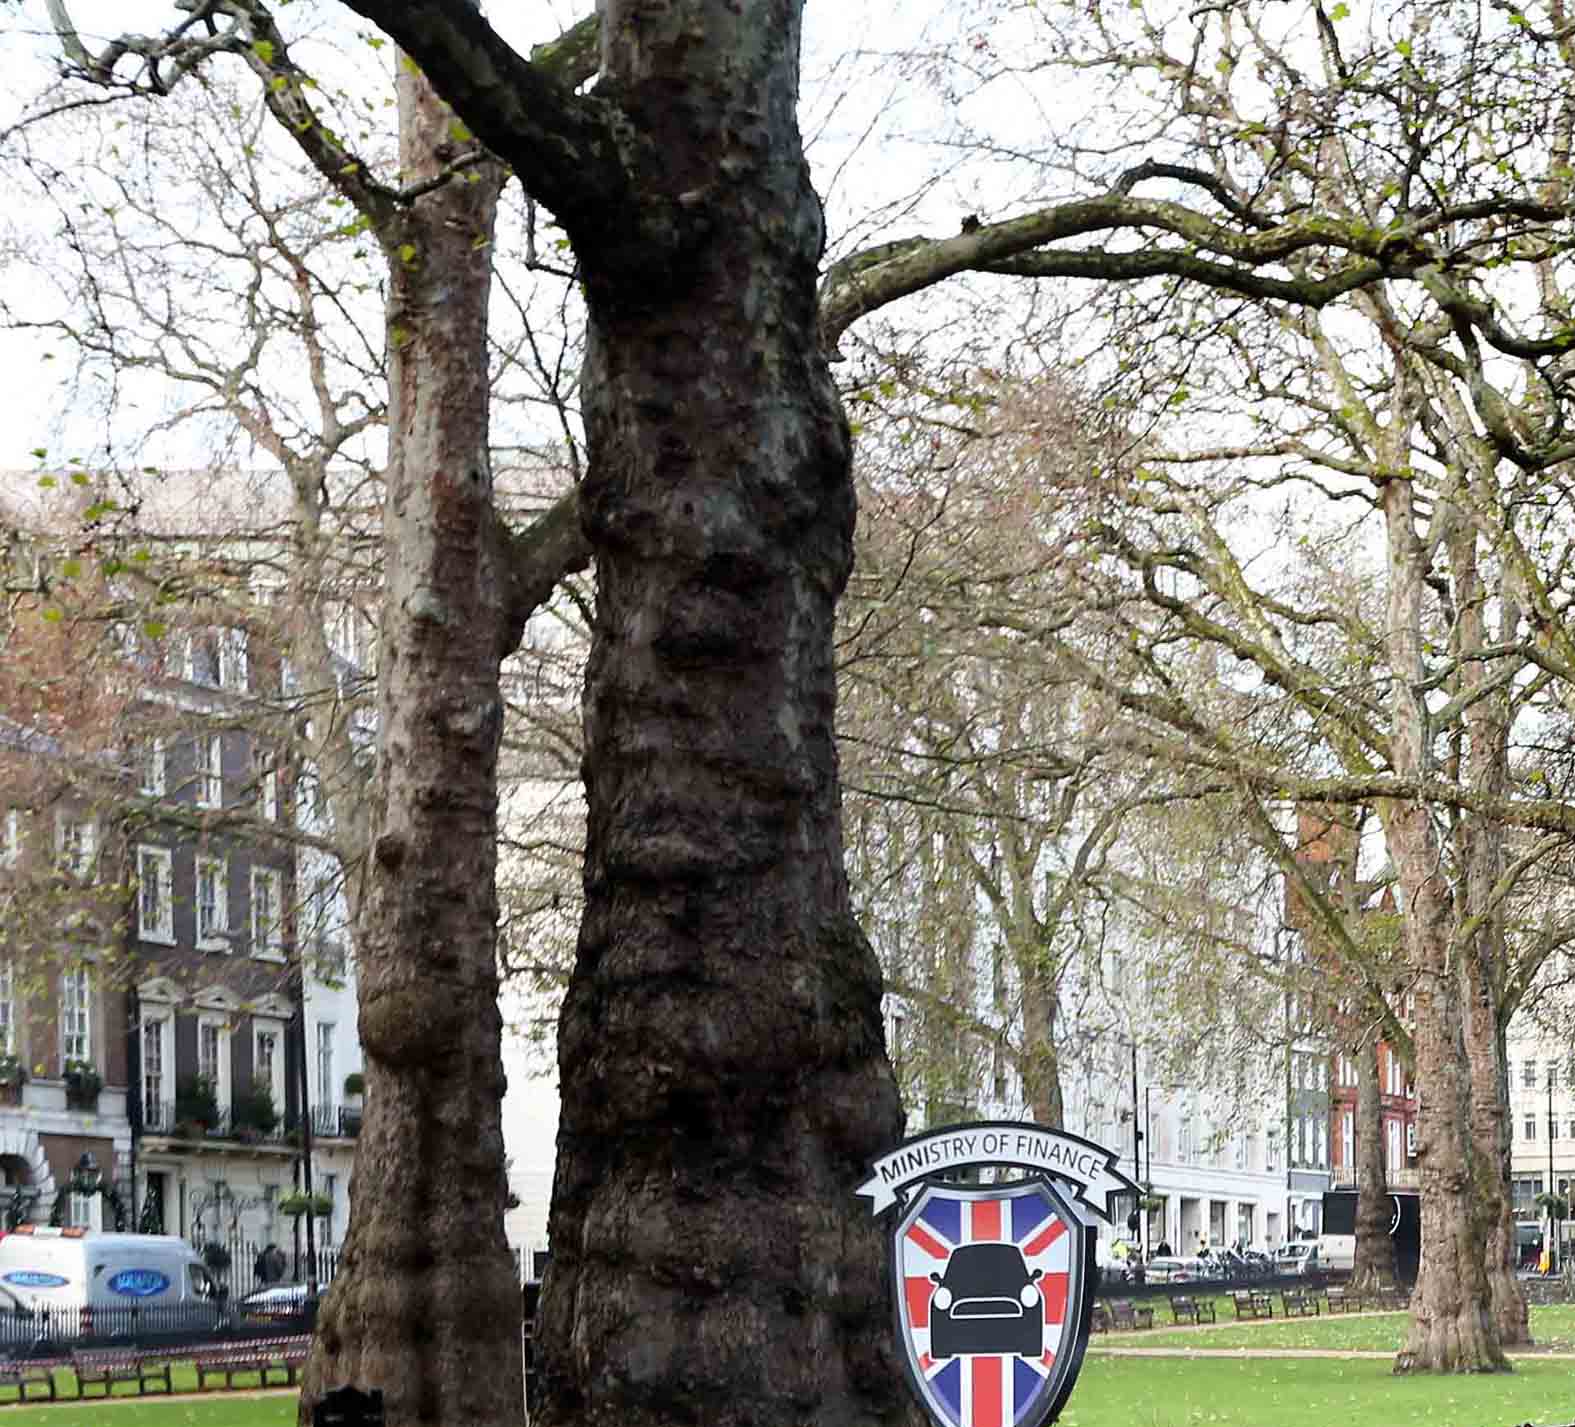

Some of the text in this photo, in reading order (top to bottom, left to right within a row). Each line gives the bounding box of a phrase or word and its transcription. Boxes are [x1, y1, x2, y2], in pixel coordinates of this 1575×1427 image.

[880, 1134, 1103, 1184] MINISTRY OF FINANCE
